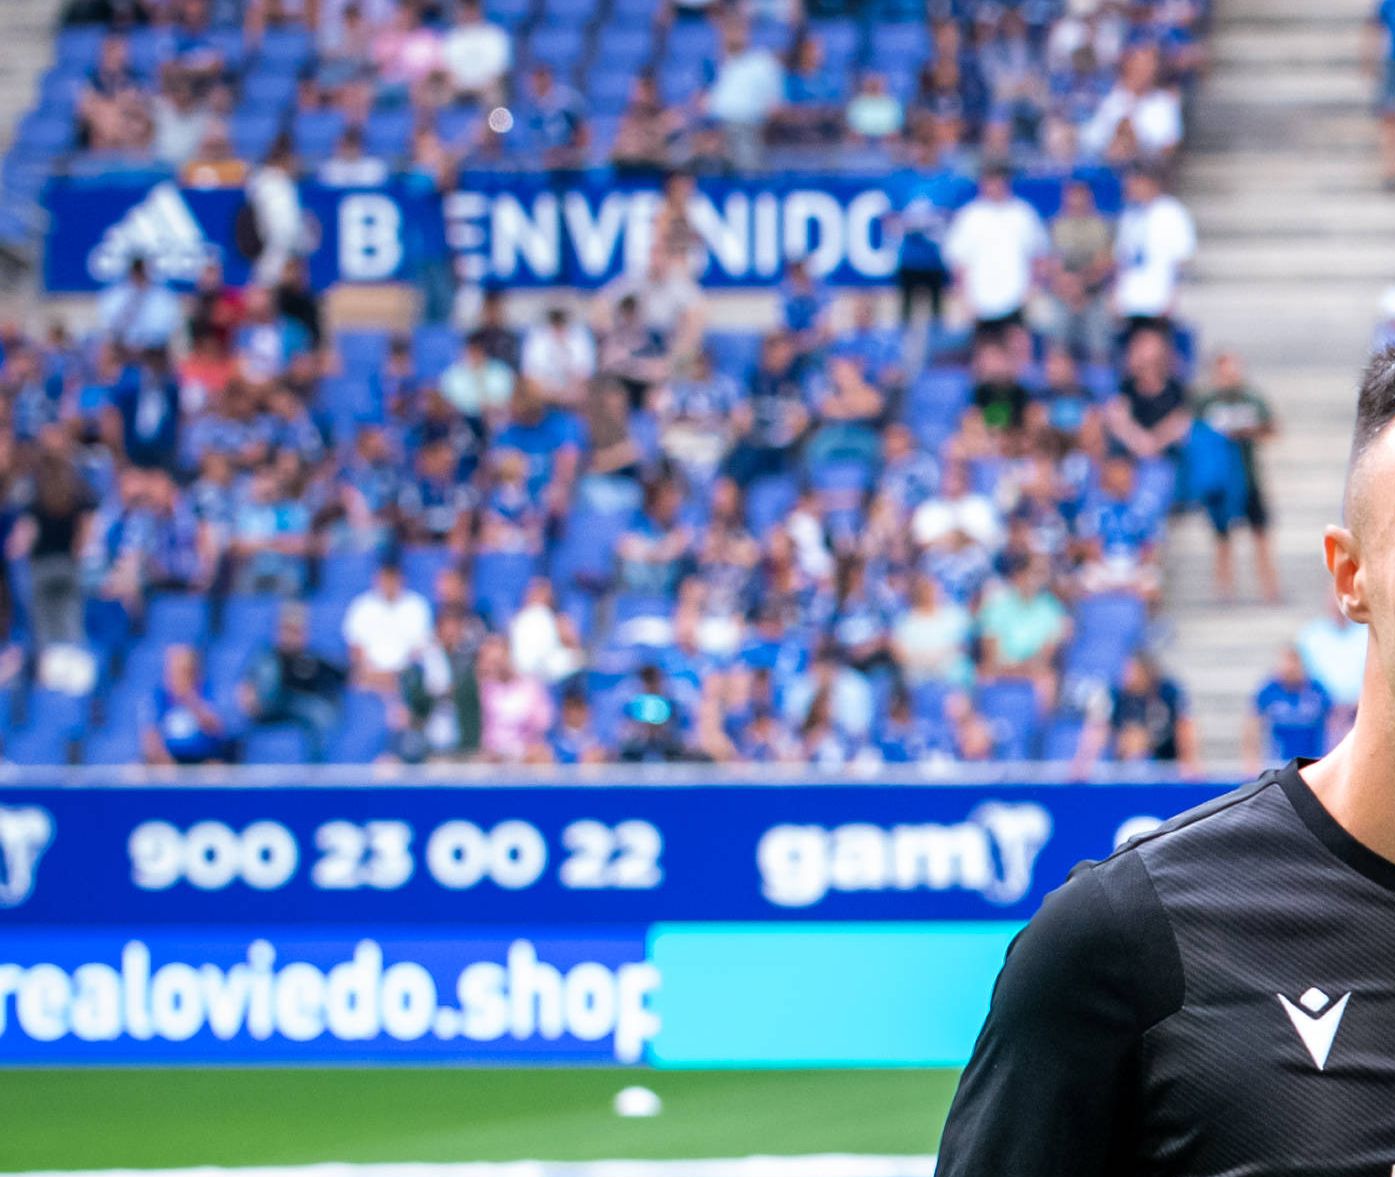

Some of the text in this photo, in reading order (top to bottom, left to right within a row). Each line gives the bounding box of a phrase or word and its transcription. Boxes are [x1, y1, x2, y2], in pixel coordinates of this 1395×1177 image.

[128, 819, 299, 890] 900
[312, 819, 415, 890] 23
[425, 819, 548, 890] 00
[559, 819, 664, 890] 22
